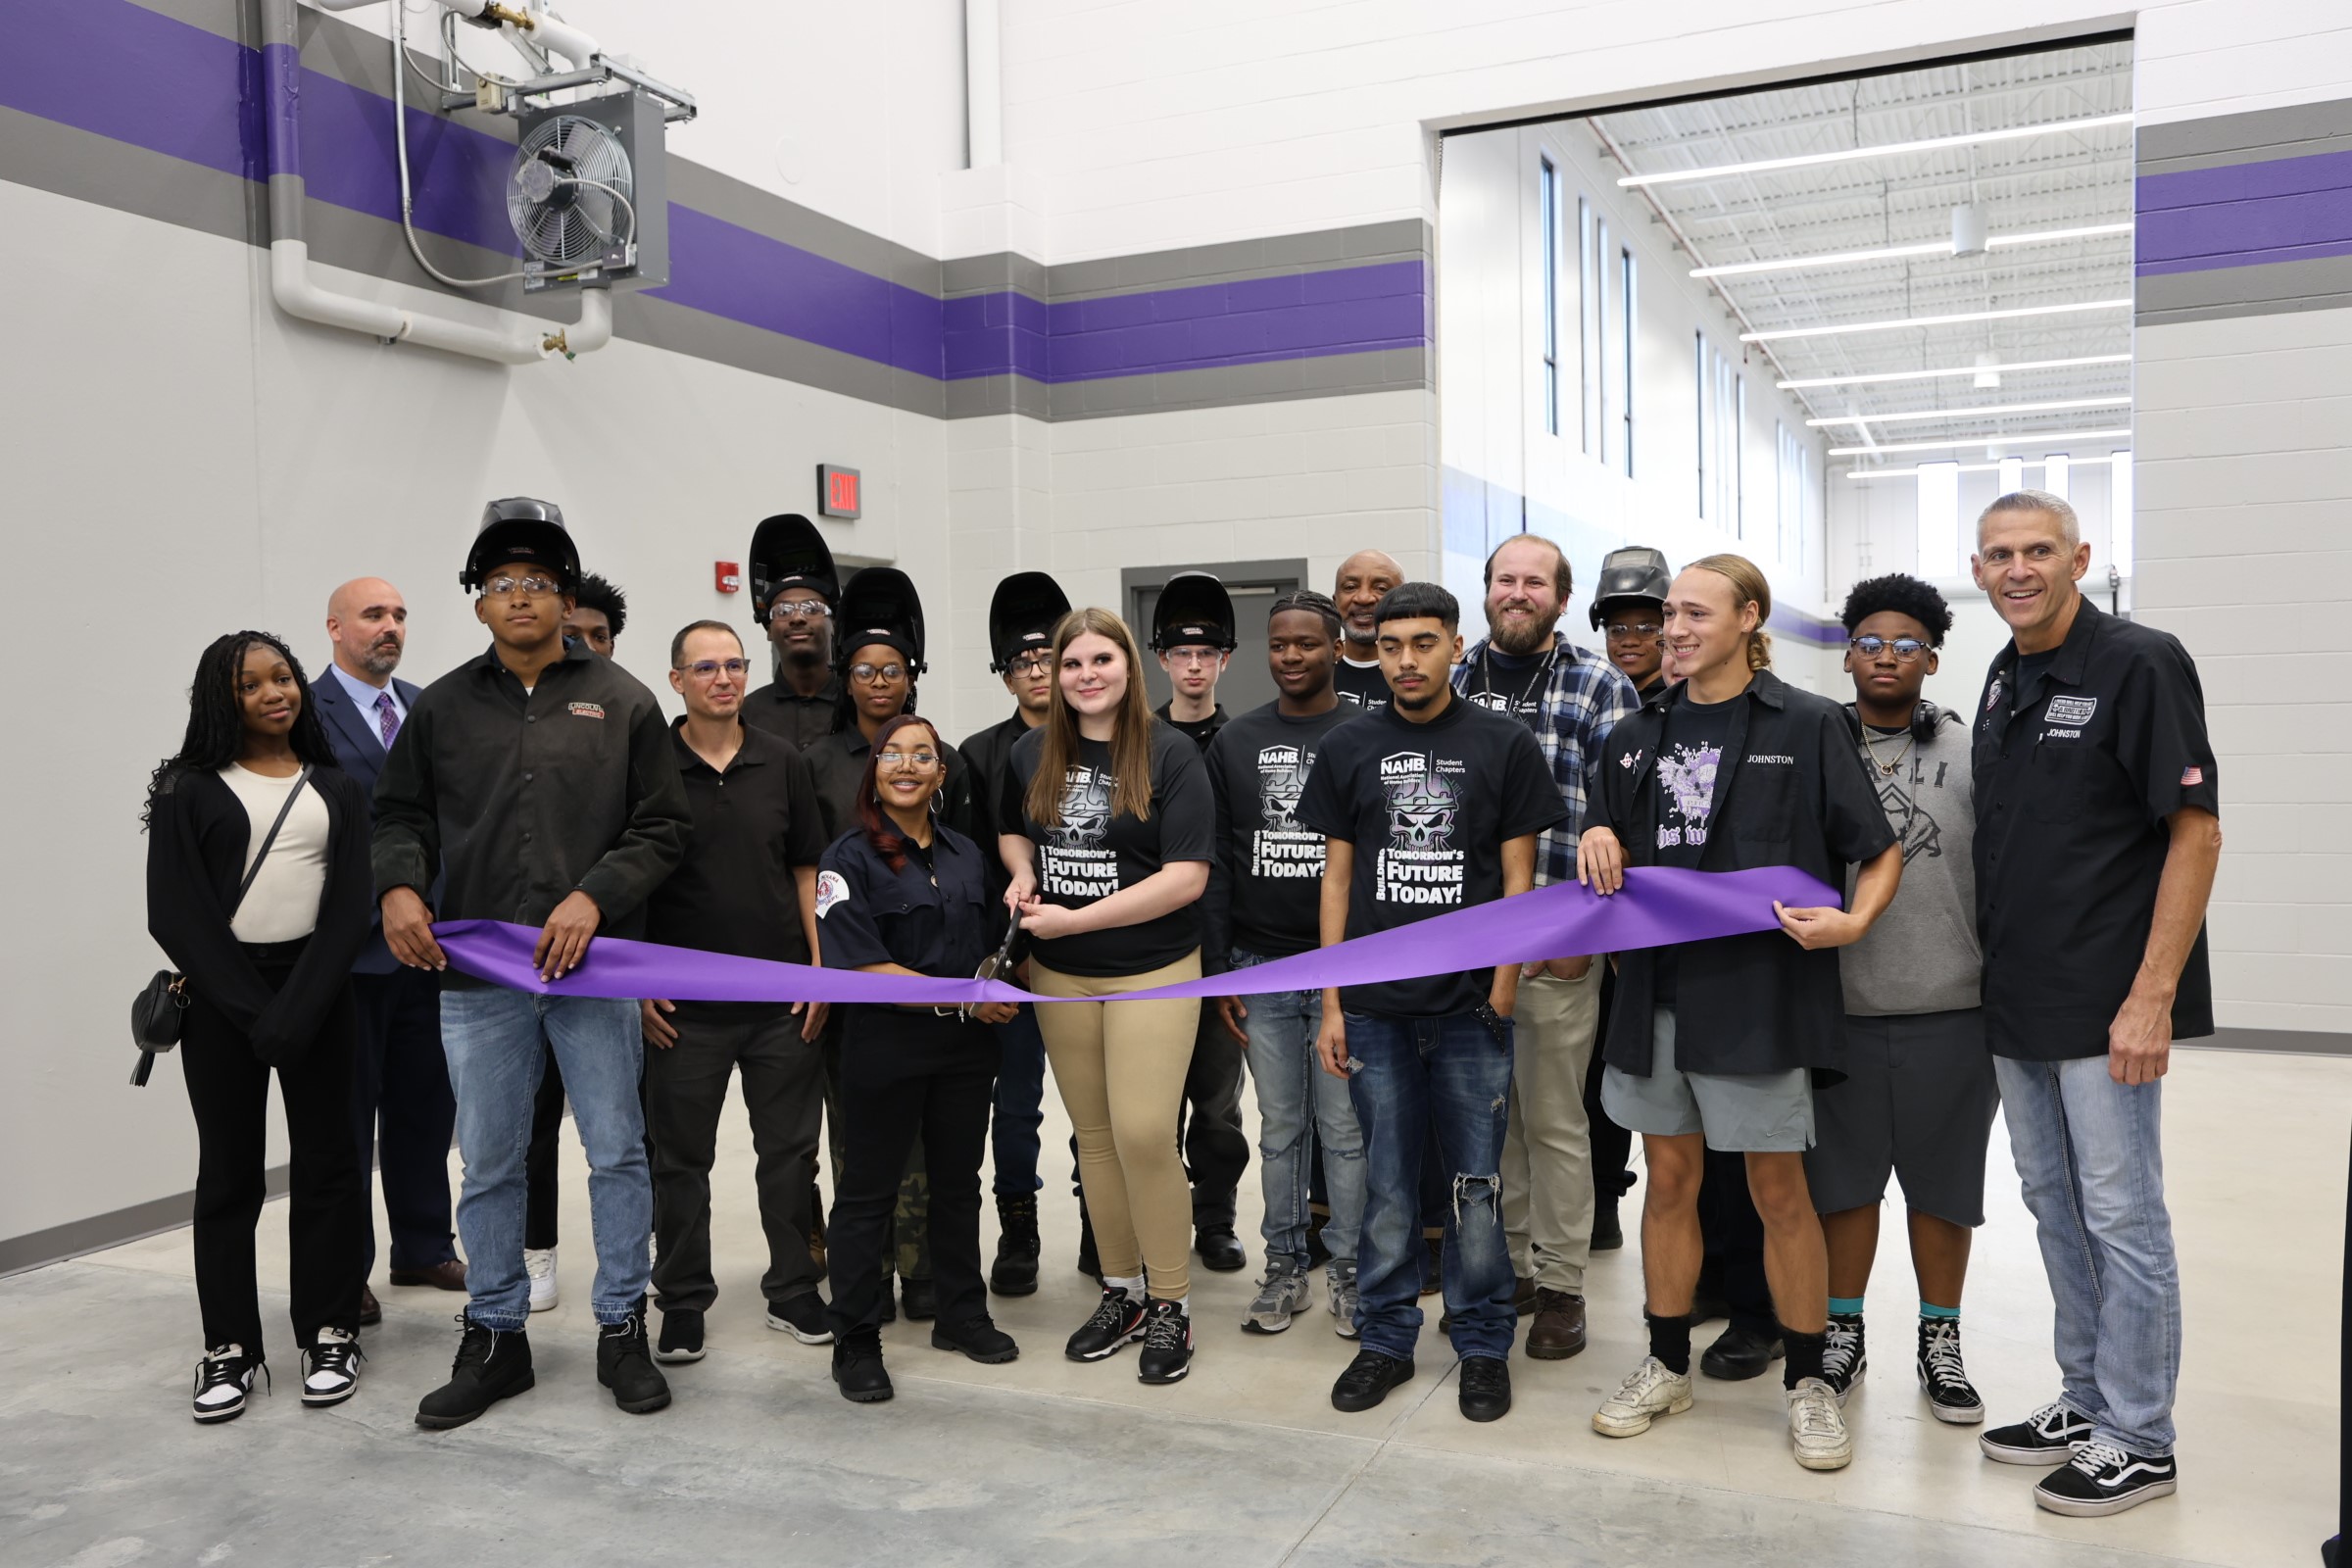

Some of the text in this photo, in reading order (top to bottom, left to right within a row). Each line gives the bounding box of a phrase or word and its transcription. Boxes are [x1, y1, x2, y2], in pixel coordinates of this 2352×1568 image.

[830, 471, 858, 512] EXIT
[568, 702, 601, 711] LINCOLN
[2047, 728, 2082, 738] JOHNSTON
[1747, 754, 1794, 764] JOHNSTON
[1046, 845, 1117, 859] TOMORROW'S
[1251, 829, 1260, 876] BUILDING
[1261, 841, 1326, 858] FUTURE
[1387, 848, 1465, 860] TOMORROW'S
[1039, 845, 1050, 892] BUILDING
[1048, 857, 1118, 878] FUTURE
[1261, 859, 1326, 877] TODAY!
[1376, 848, 1386, 902] BUILDING
[1387, 860, 1464, 882] FUTURE
[1049, 875, 1119, 897] TODAY!
[1387, 882, 1463, 904] TODAY!
